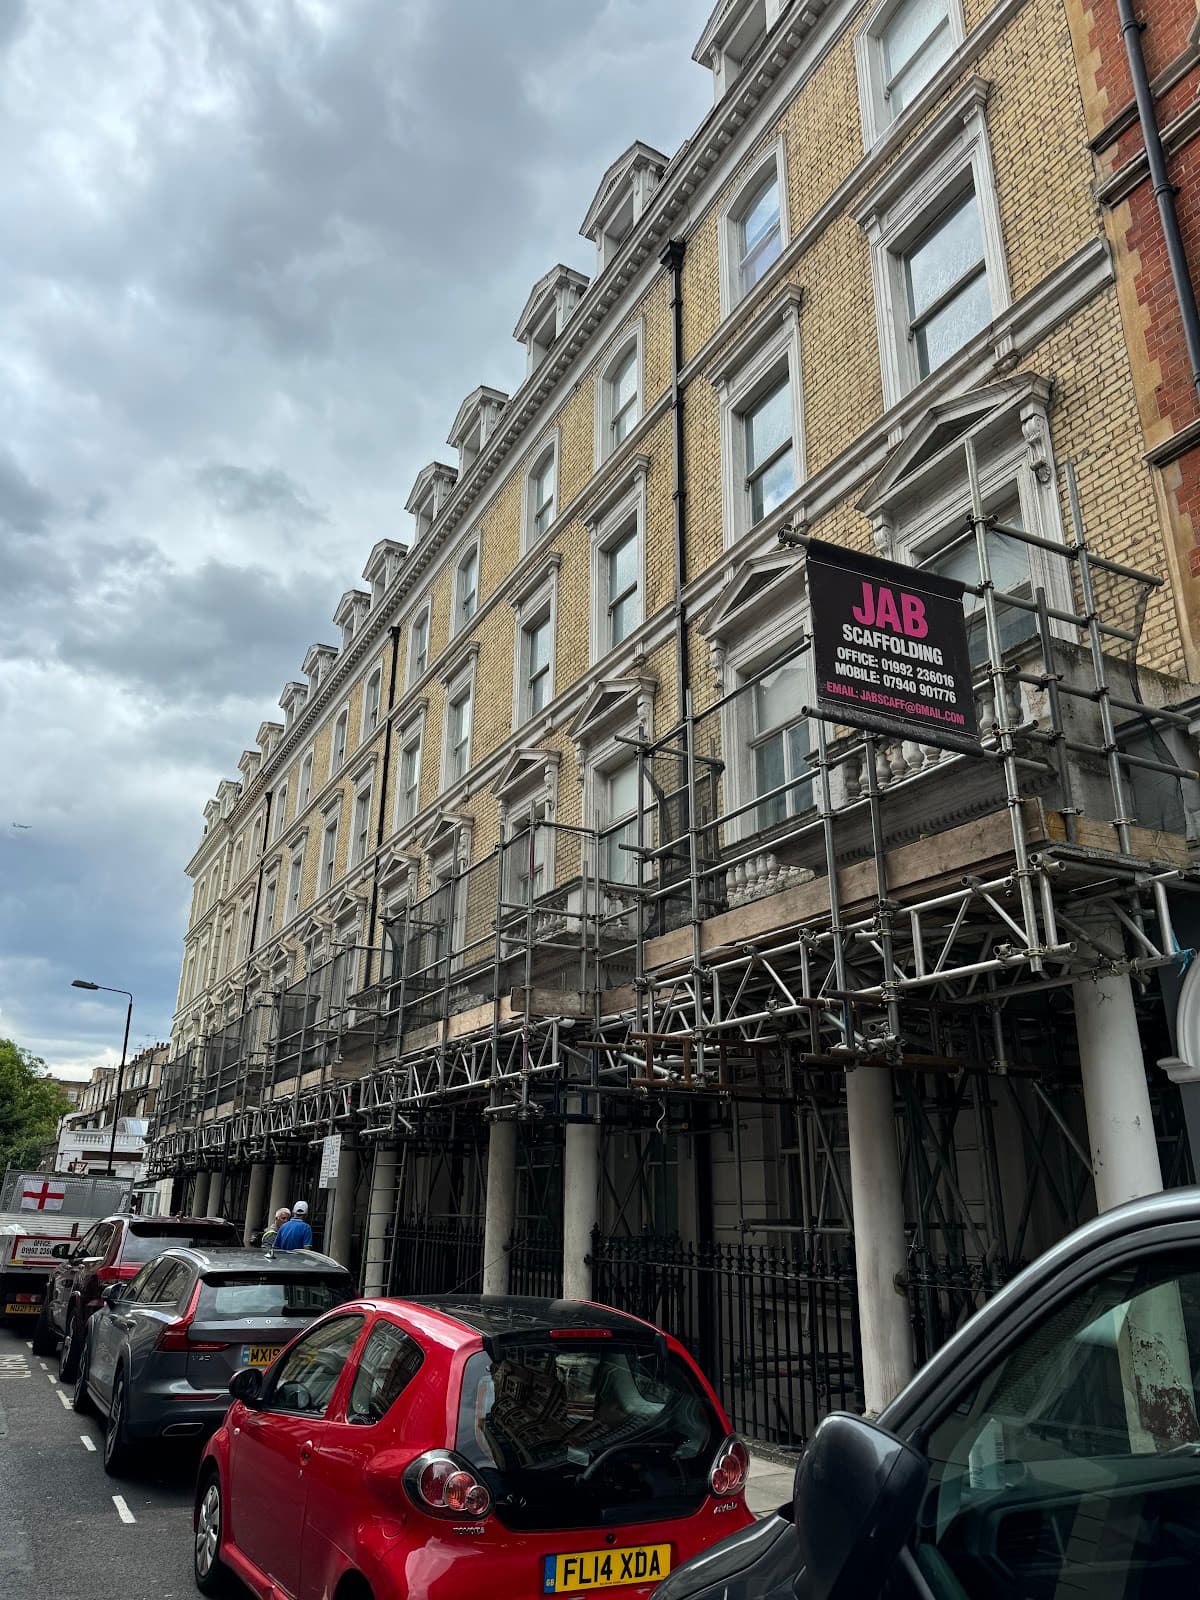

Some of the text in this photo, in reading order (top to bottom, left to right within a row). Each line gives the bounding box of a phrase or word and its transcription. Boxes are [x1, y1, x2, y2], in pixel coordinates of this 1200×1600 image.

[852, 581, 929, 639] JAB
[842, 623, 944, 666] SCAFFOLDING
[835, 662, 957, 704] MOBILE: 07940 901776
[836, 646, 955, 688] OFFICE: 01992 236016
[826, 680, 965, 725] EMAIL: JABSCAFF@GMAIL.COM
[563, 1549, 661, 1586] FL14 XDA
